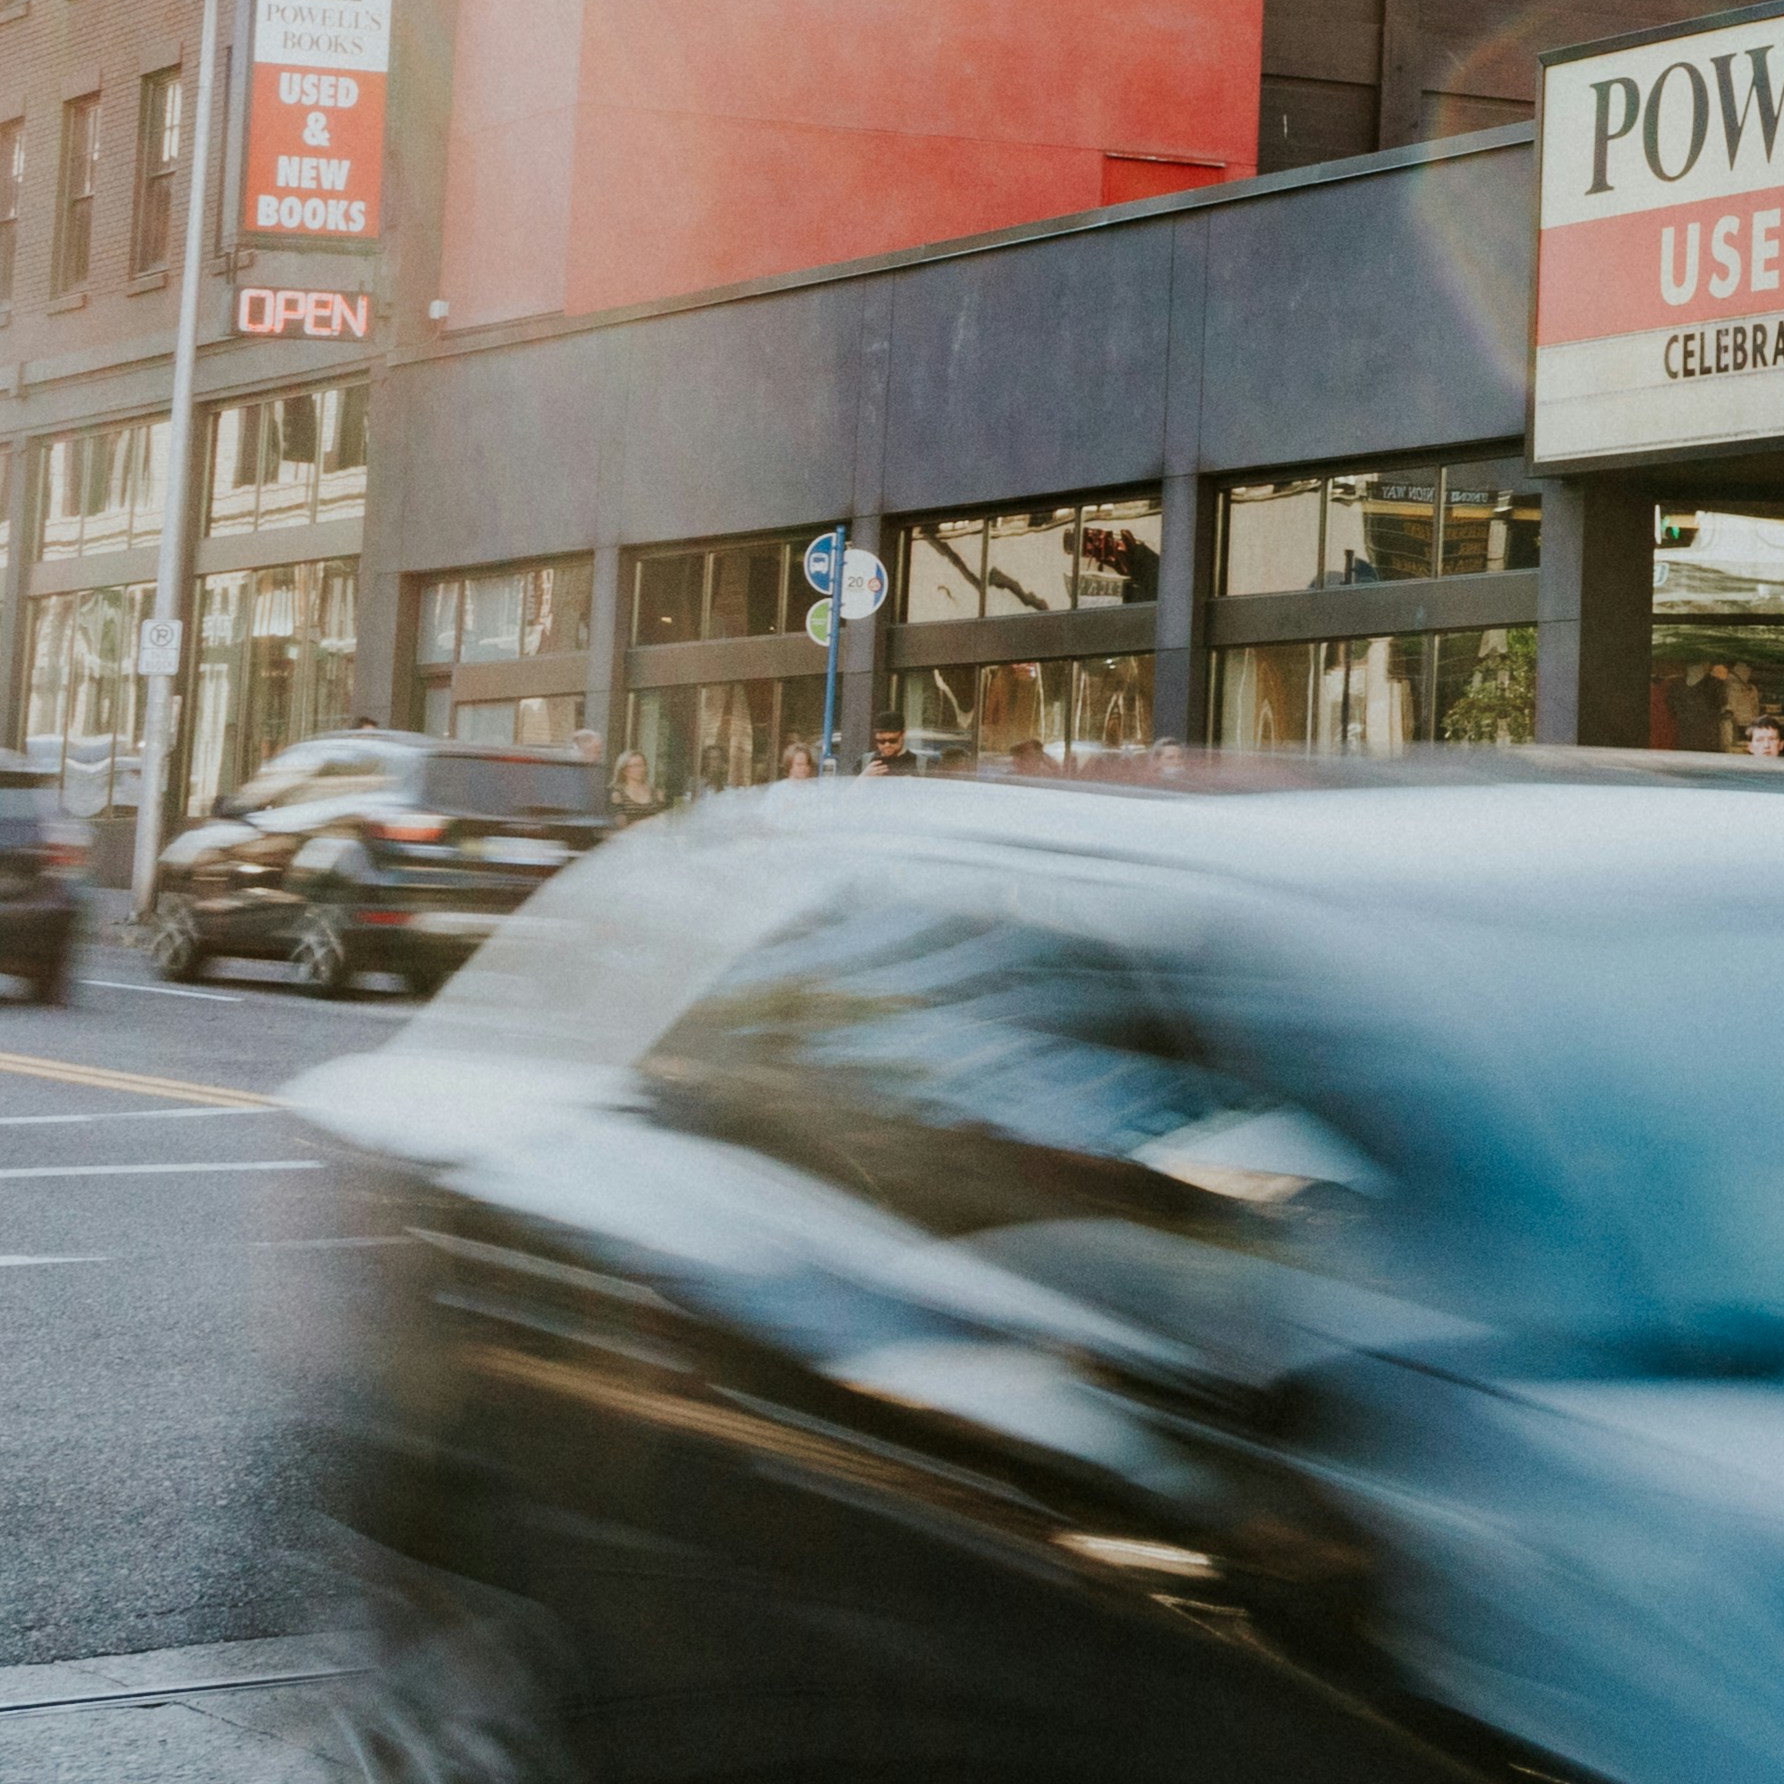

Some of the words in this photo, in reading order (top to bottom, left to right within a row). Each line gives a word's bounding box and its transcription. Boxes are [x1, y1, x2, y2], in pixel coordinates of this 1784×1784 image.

[266, 3, 383, 32] POWELL'S
[282, 30, 364, 56] BOOKS
[278, 72, 360, 108] USED
[302, 111, 331, 147] &
[275, 154, 351, 192] NEW
[256, 194, 367, 233] BOOKS
[237, 287, 369, 338] OPEN
[847, 576, 864, 588] 20
